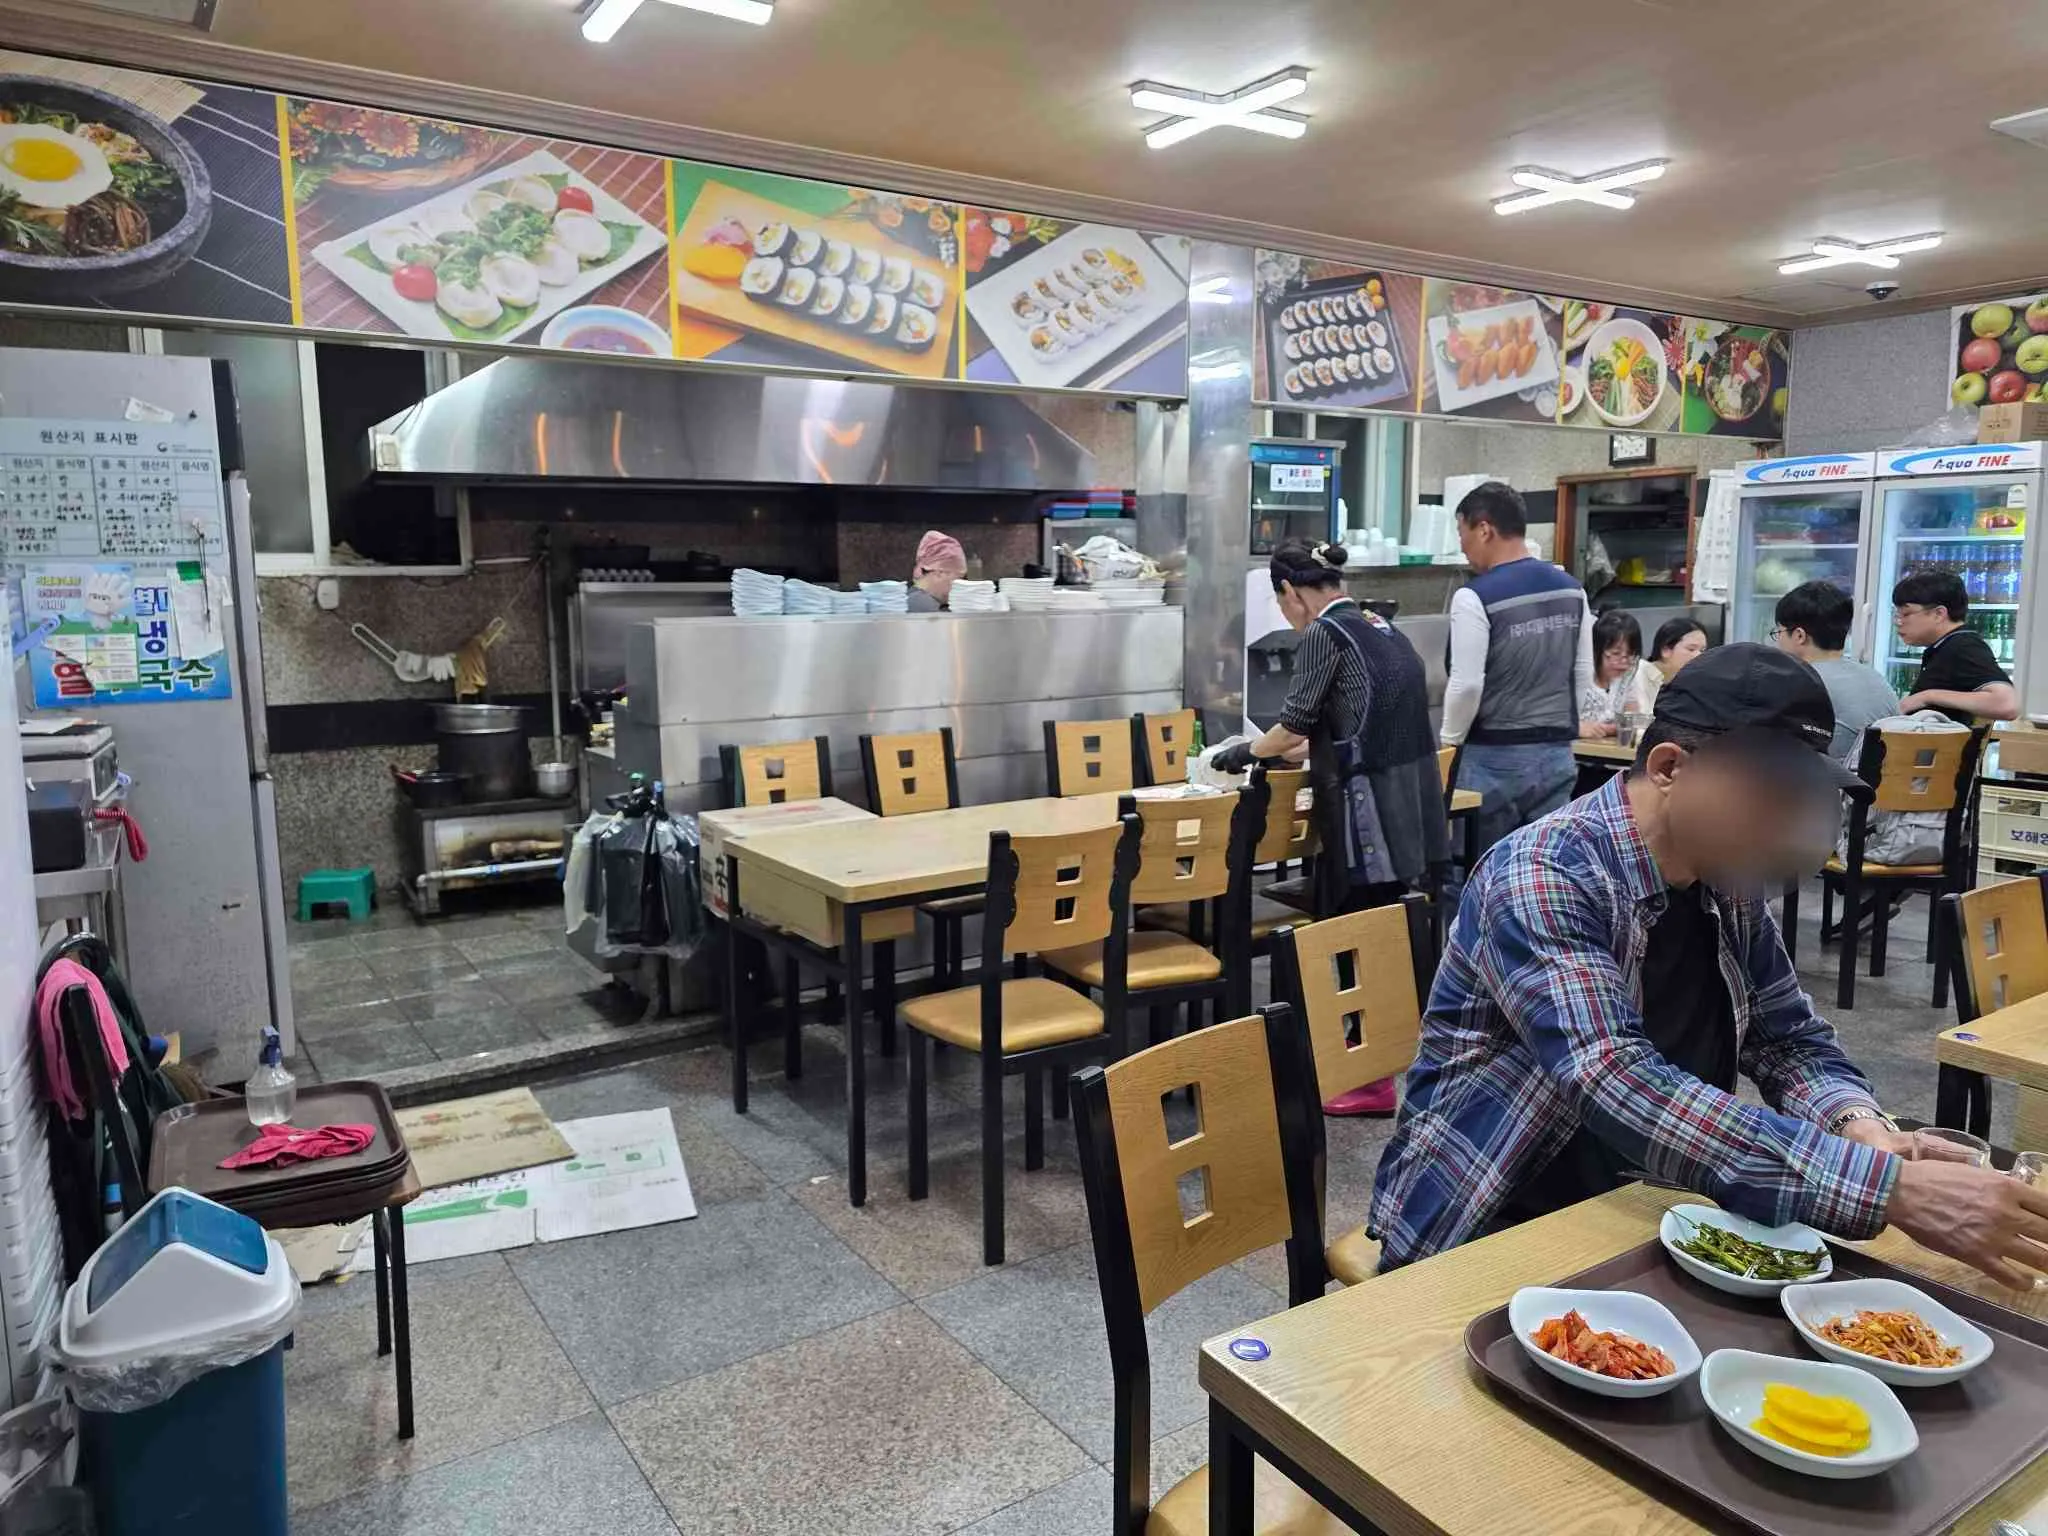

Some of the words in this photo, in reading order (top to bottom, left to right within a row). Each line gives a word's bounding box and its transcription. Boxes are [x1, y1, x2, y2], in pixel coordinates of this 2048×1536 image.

[40, 429, 85, 444] 원산지
[94, 432, 138, 446] 표시판
[1932, 459, 1973, 470] Aqua
[1977, 454, 2012, 467] FINE
[1782, 467, 1816, 478] Aqua
[1820, 464, 1849, 476] FINE
